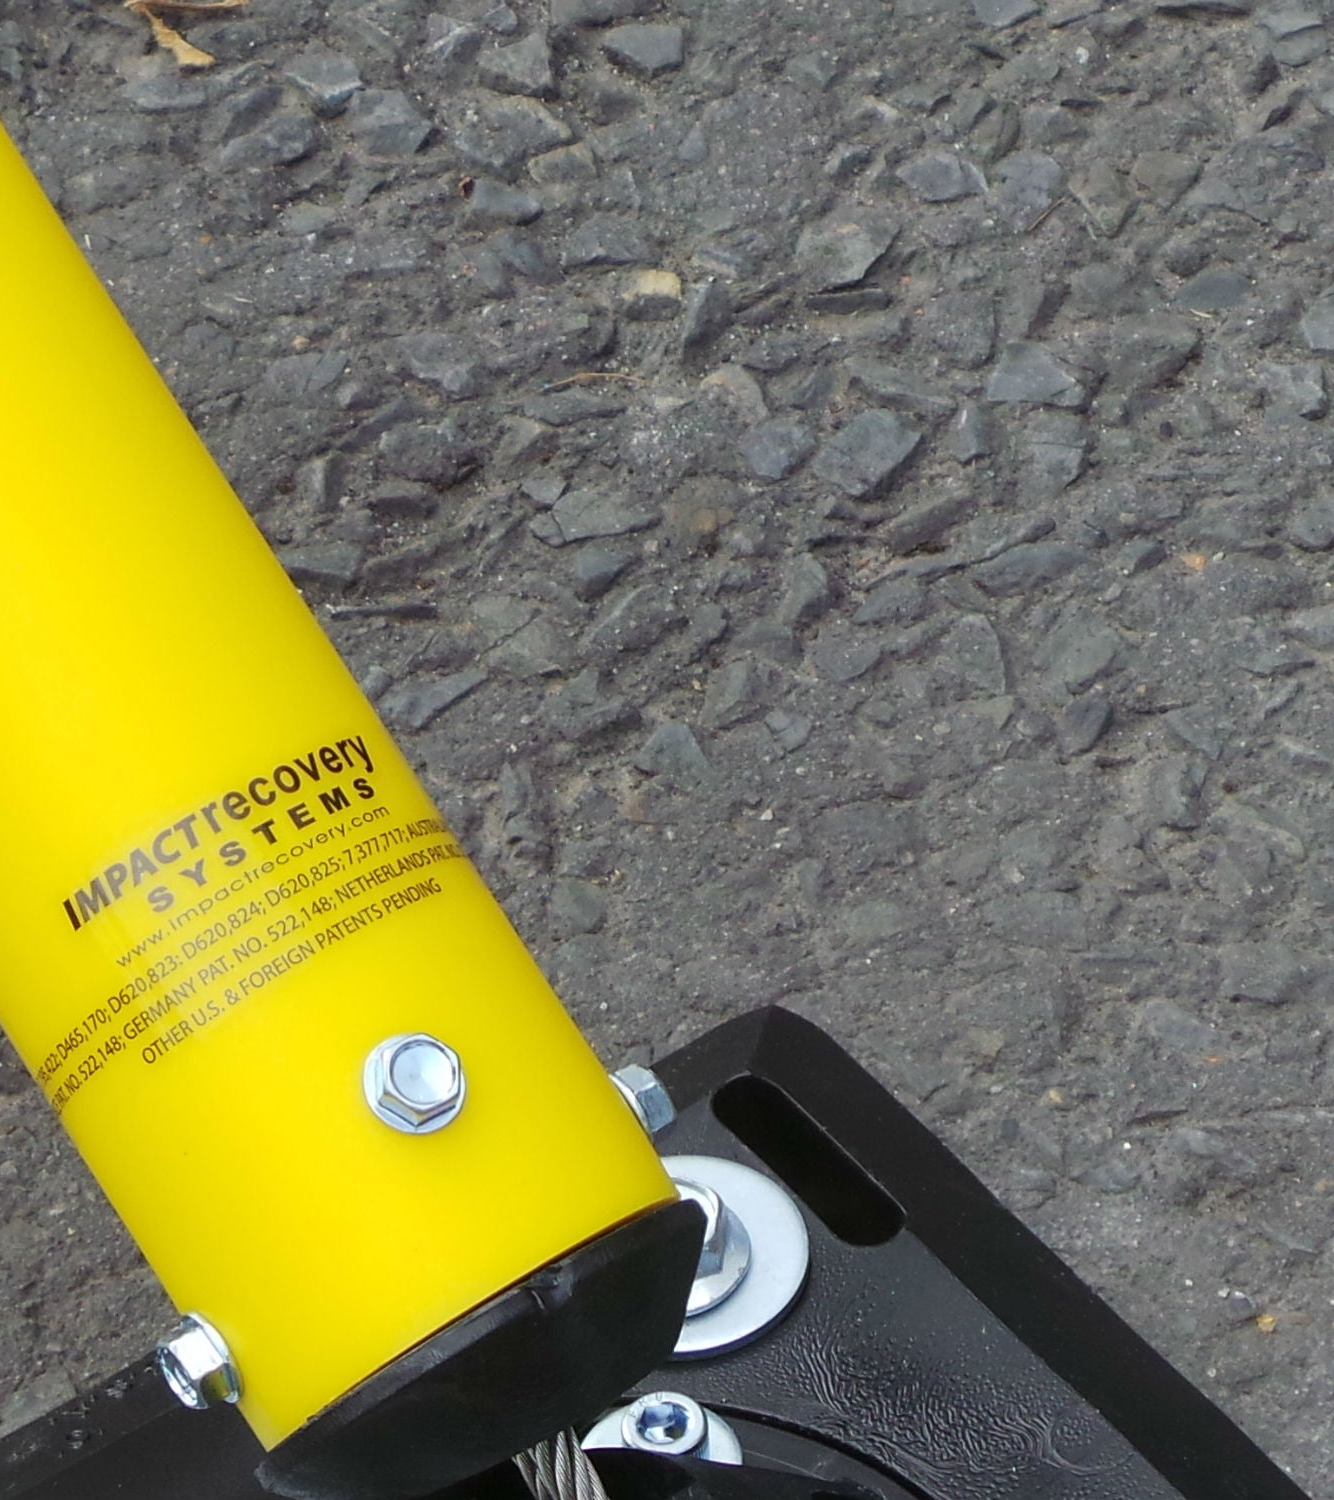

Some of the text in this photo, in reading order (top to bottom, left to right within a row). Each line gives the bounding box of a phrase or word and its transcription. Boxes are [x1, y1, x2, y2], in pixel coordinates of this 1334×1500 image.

[116, 805, 390, 968] www.impactrecovery.com
[147, 777, 375, 914] SYSTEMS
[56, 1008, 112, 1060] D465,170;
[181, 900, 266, 960] D620,824;
[264, 858, 346, 908] D620,825;
[342, 828, 410, 866] 7,377,717;
[78, 1035, 126, 1080] 522,148;
[123, 977, 197, 1039] GERMANY
[197, 956, 234, 986] PAT.
[232, 936, 267, 963] NO.
[267, 896, 337, 942] 522,148;
[334, 850, 431, 904] NETHERLANDS
[142, 877, 442, 1064] OTHER U.S. & FOREIGN PATENTS PENDING
